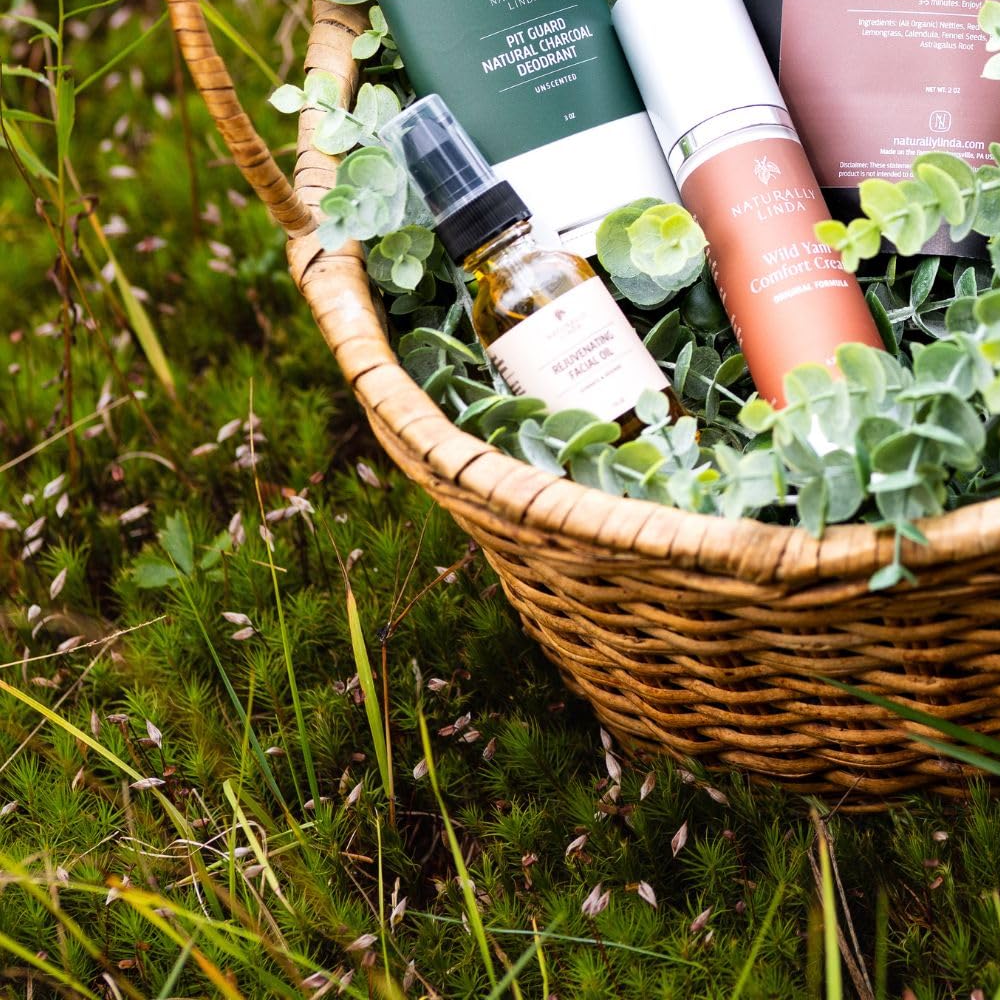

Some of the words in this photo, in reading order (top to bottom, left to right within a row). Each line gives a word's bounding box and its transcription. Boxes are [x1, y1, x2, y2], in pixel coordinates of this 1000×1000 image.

[506, 31, 526, 48] PIT
[527, 17, 566, 40] GUARD
[920, 40, 956, 50] Astragalus
[958, 41, 974, 50] Root
[941, 31, 964, 39] Fennel
[481, 45, 539, 73] NATURAL
[538, 24, 593, 51] CHARCOAL
[517, 45, 578, 77] DEODRANT
[535, 73, 577, 94] UNSCENTED
[893, 136, 985, 150] naturallylinda.com
[731, 187, 816, 217] NATURALLY
[757, 201, 806, 221] LINDA
[762, 243, 799, 266] Wild
[801, 241, 832, 254] Yam
[750, 257, 811, 294] Comfort
[814, 257, 845, 270] Crea
[814, 279, 849, 289] FORMULA
[552, 330, 614, 375] REJUVENATING
[569, 356, 600, 379] FACIAL
[599, 347, 614, 360] OIL
